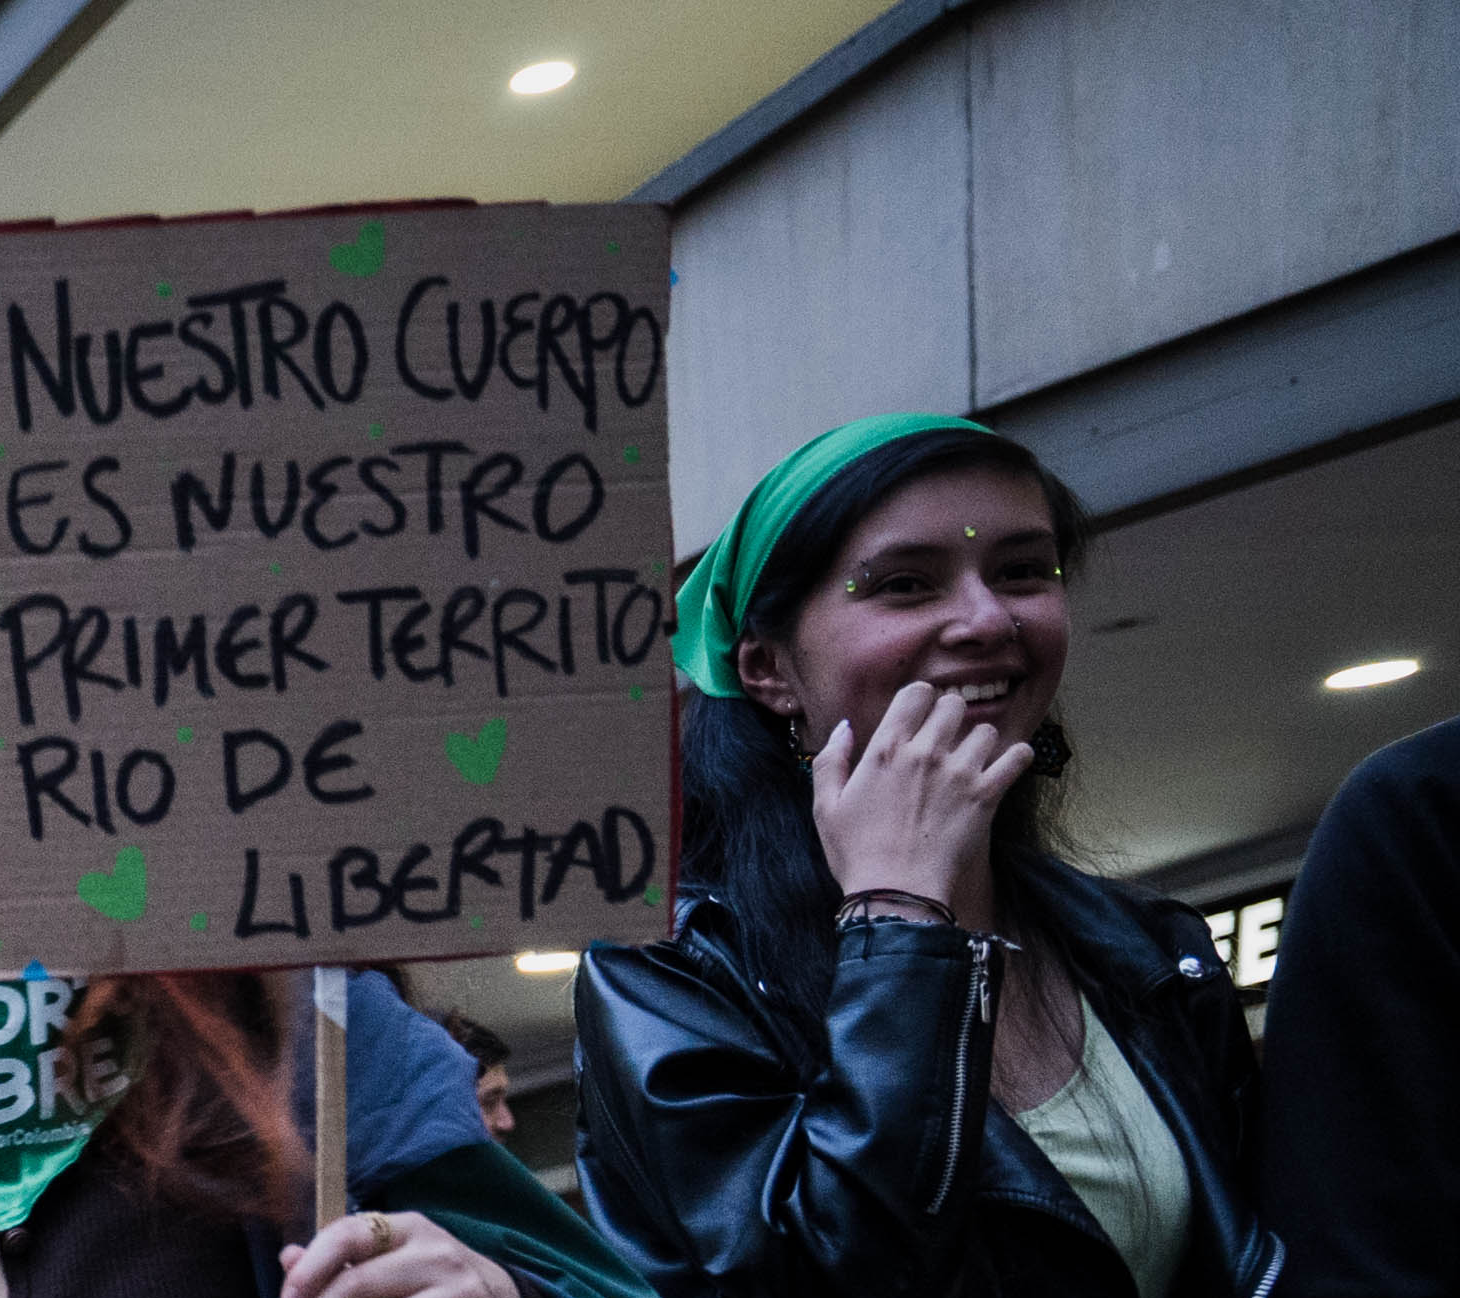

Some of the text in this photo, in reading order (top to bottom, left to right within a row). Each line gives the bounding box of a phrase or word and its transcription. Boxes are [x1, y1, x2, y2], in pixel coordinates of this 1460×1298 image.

[7, 274, 666, 434] NUESTRO CUERPO
[6, 439, 605, 559] ES NUESTRO
[17, 719, 376, 840] RIO DE
[234, 805, 657, 939] LIBERTAD
